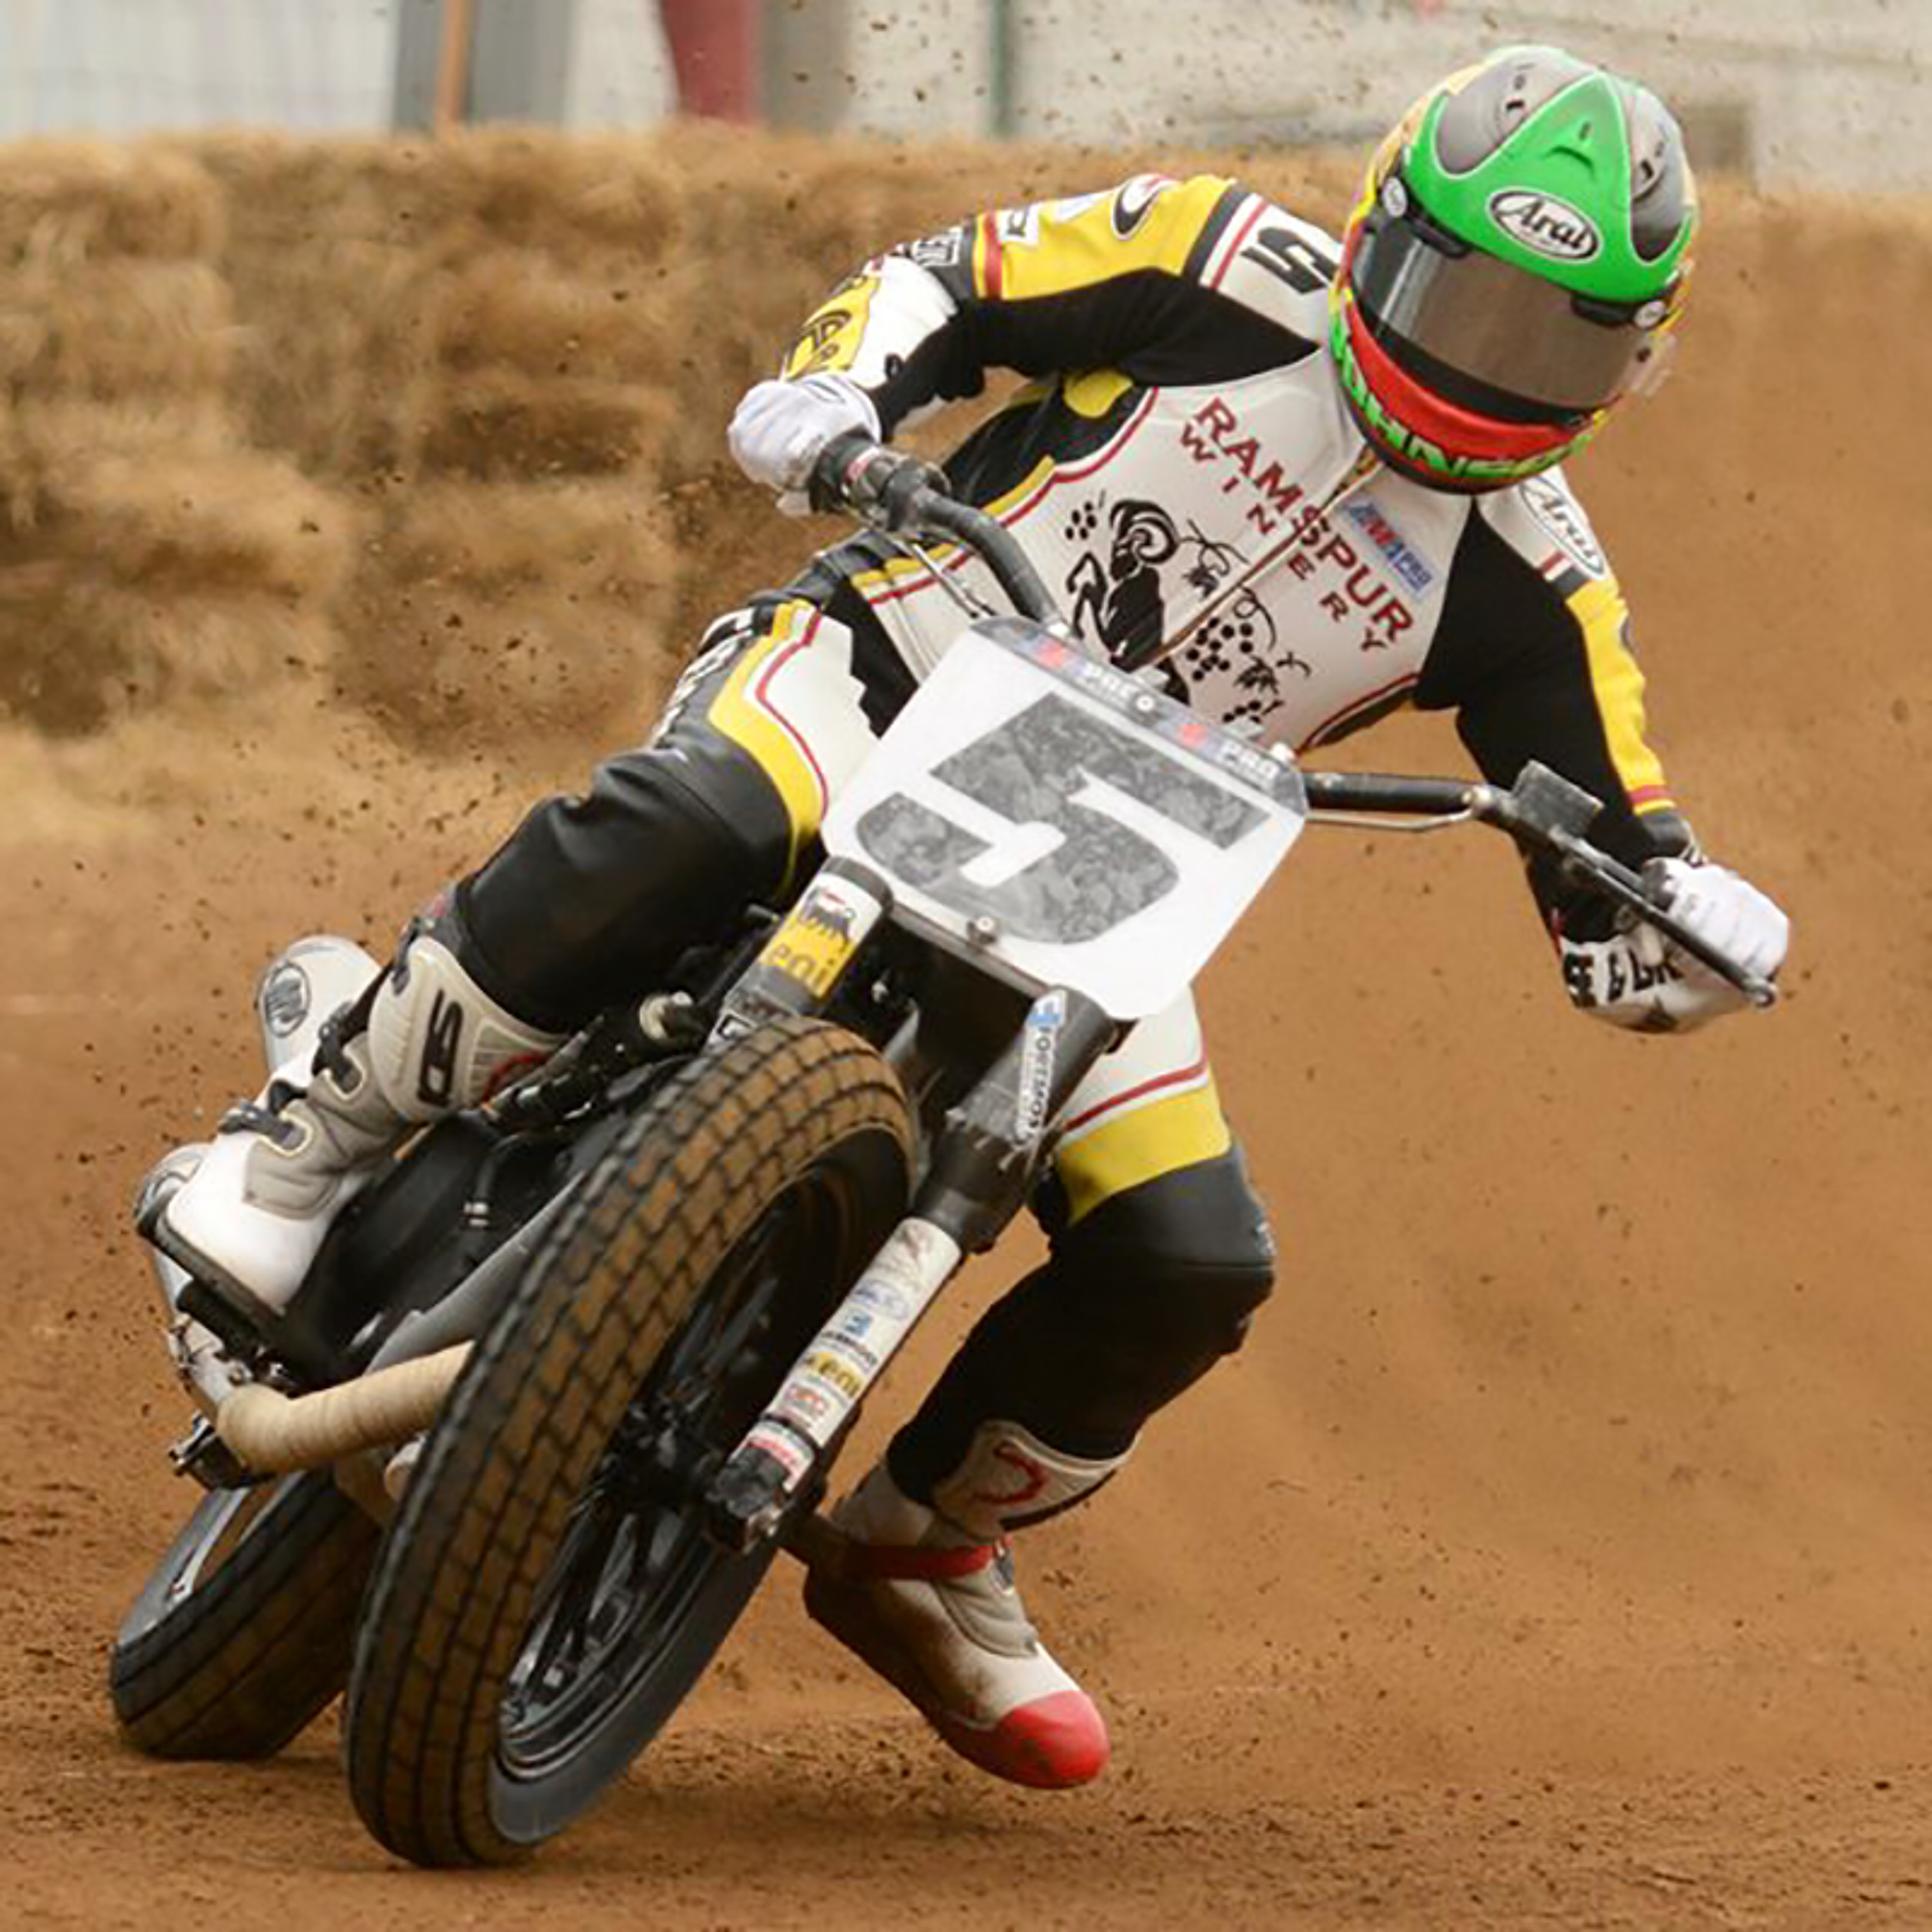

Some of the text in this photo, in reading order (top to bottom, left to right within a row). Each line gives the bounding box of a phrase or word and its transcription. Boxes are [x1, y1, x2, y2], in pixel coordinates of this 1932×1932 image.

[1495, 196, 1592, 250] Arai
[1179, 421, 1388, 652] WINERY
[1195, 397, 1414, 643] RAMSPUR
[856, 691, 1271, 945] 5
